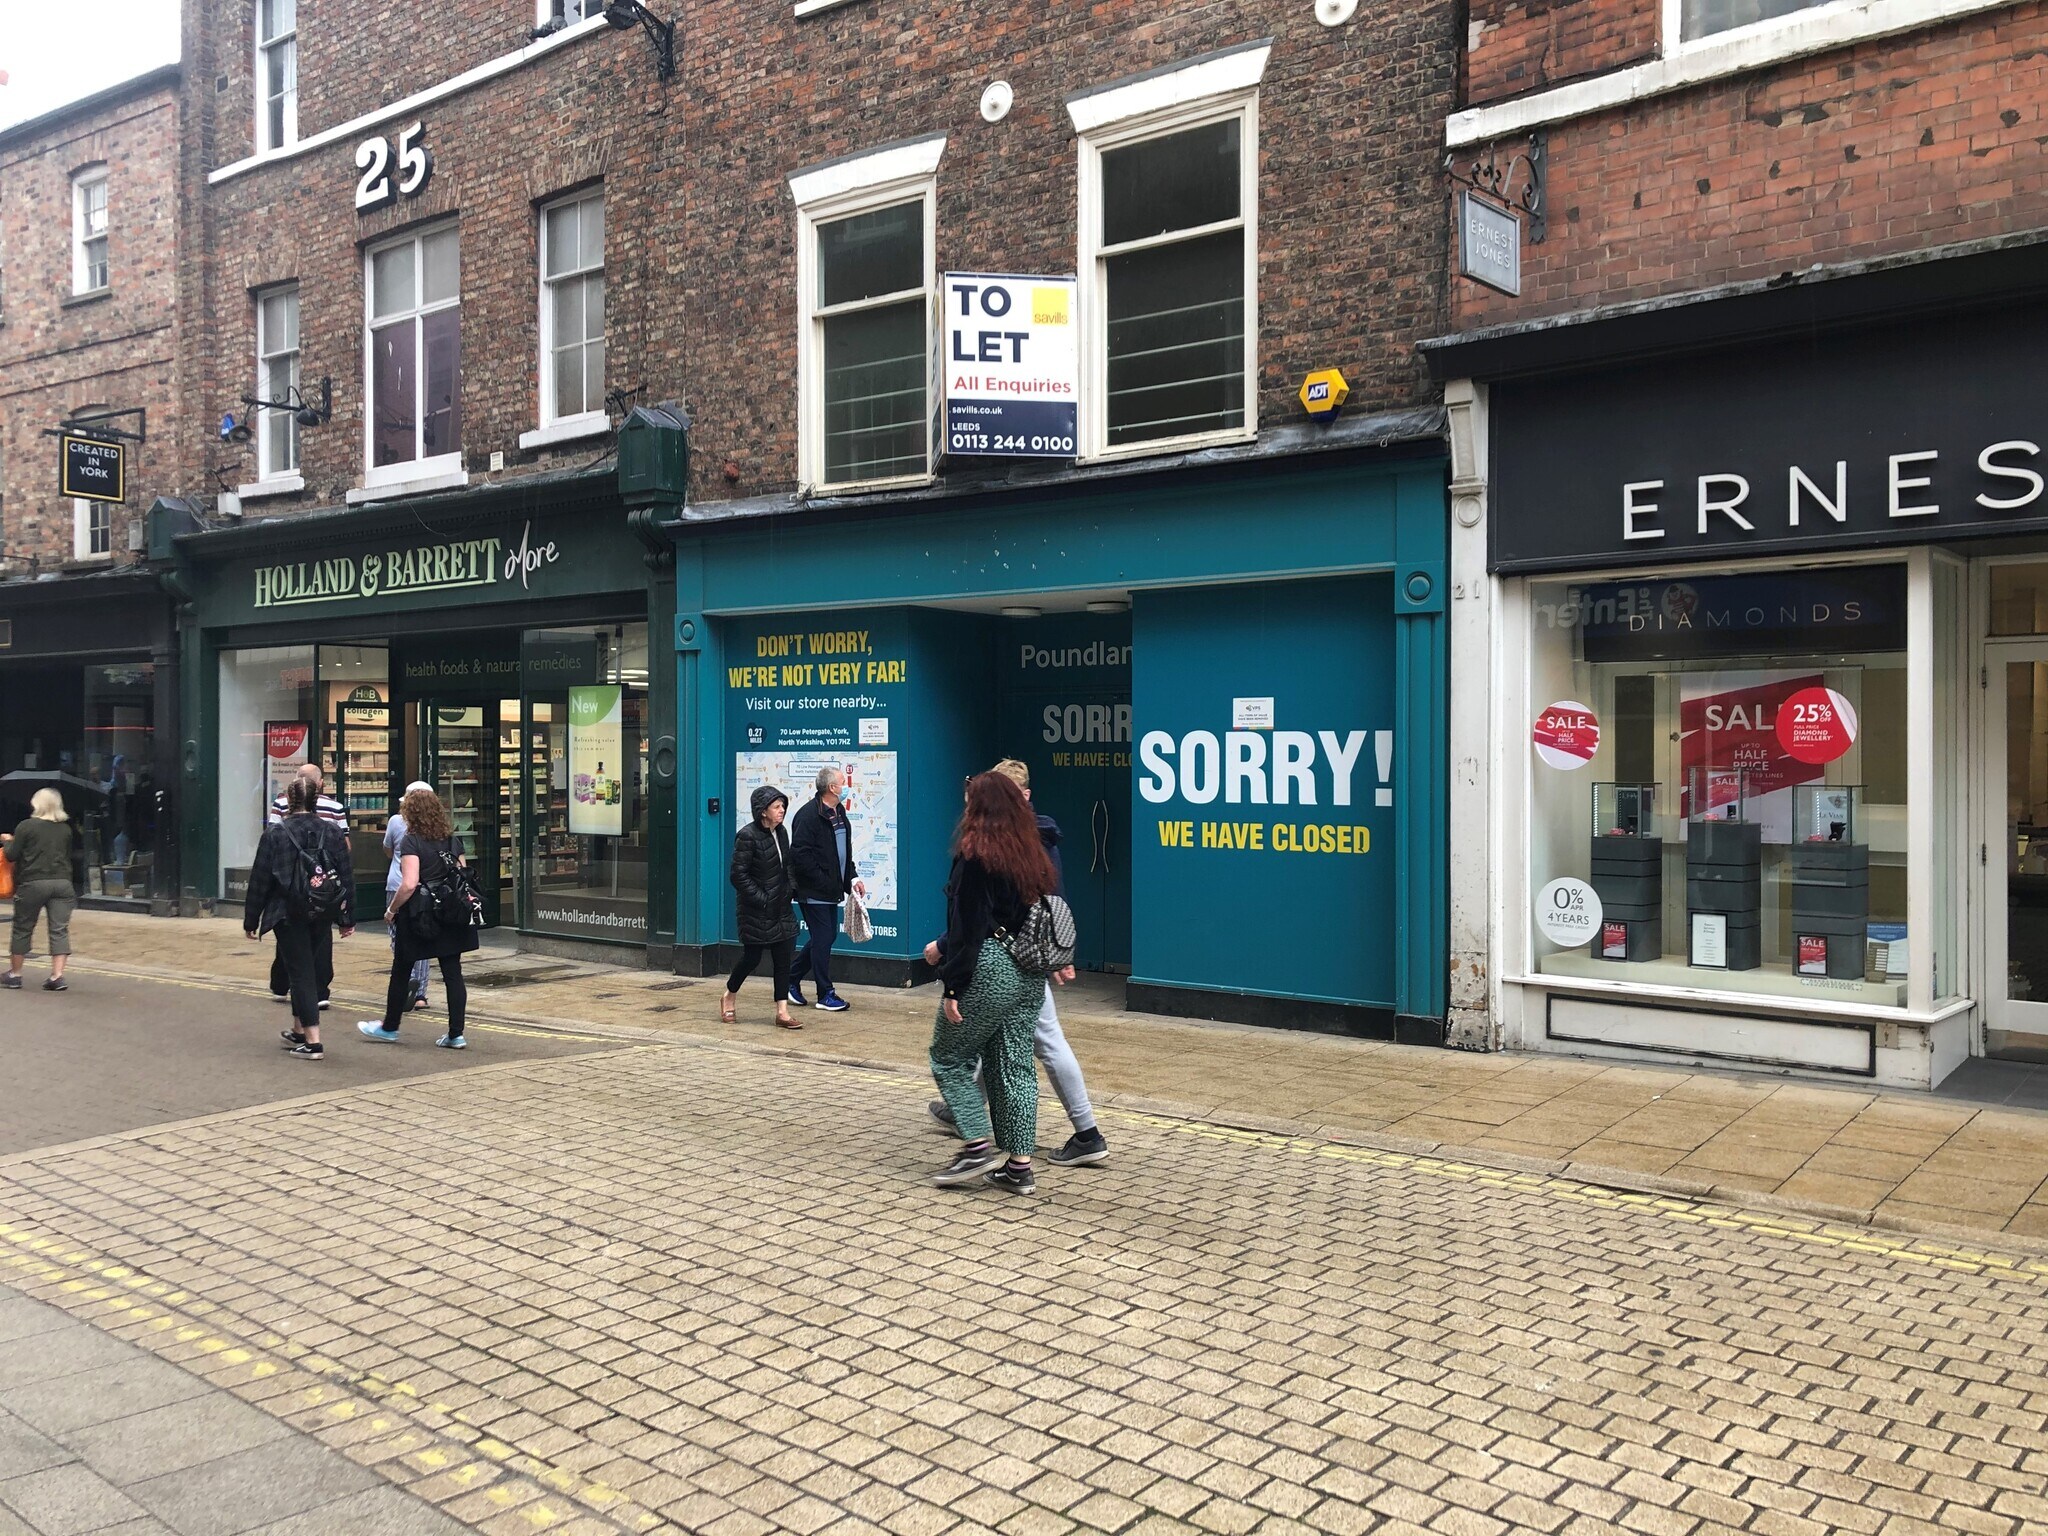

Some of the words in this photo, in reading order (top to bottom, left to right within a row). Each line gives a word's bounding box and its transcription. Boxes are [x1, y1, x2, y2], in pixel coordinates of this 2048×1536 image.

[355, 121, 429, 209] 25
[1471, 219, 1513, 250] ERNEST
[1475, 241, 1511, 269] JONES
[952, 285, 1012, 318] TO
[1034, 312, 1068, 325] savills
[953, 330, 1029, 363] LET
[954, 376, 979, 391] All
[986, 377, 1072, 394] Enquiries
[1307, 384, 1329, 400] ADT
[952, 405, 1003, 415] savills.co.uk
[952, 422, 981, 431] LEEDS
[69, 443, 118, 459] CREATED
[952, 433, 989, 449] 0113
[993, 435, 1026, 450] 244
[1031, 436, 1074, 451] 0100
[88, 456, 100, 466] IN
[79, 466, 109, 479] YORK
[1623, 440, 2045, 540] ERNES
[254, 557, 356, 607] HOLLAND
[360, 553, 382, 597] &
[386, 538, 501, 588] BARRETT
[504, 519, 560, 590] More
[1629, 602, 1862, 632] DIAMONDS
[757, 634, 804, 657] DON'T
[808, 631, 873, 656] WORRY,
[1021, 641, 1132, 669] Poundlan
[405, 661, 437, 678] health
[440, 659, 469, 676] foods
[473, 658, 482, 674] &
[486, 660, 520, 673] natura
[528, 653, 582, 671] remedies
[728, 666, 778, 688] WE'RE
[782, 664, 813, 687] NOT
[818, 662, 862, 685] VERY
[867, 660, 906, 684] FAR!
[571, 695, 598, 714] New
[746, 697, 772, 711] Visit
[774, 699, 795, 710] our
[798, 697, 829, 710] store
[833, 694, 887, 711] nearby...
[1705, 704, 1781, 732] SAL
[1793, 703, 1832, 723] 25%
[1043, 704, 1132, 743] SORR
[1546, 716, 1586, 729] SALE
[748, 728, 763, 738] 0.27
[780, 728, 788, 736] 70
[788, 728, 801, 736] Low
[802, 728, 832, 737] Petergate,
[833, 727, 850, 736] York,
[271, 736, 284, 747] Half
[285, 736, 299, 747] Price
[796, 738, 825, 747] Yorkshire,
[1053, 752, 1071, 767] WE
[1074, 752, 1110, 767] HAVE
[1734, 750, 1768, 760] HALF
[1139, 730, 1393, 807] SORRY!
[1715, 778, 1740, 786] SALE
[1158, 821, 1194, 847] WE
[1202, 822, 1264, 849] HAVE
[1272, 824, 1370, 854] CLOSED
[1554, 887, 1584, 909] 0%
[870, 926, 898, 937] STORES
[1800, 938, 1825, 948] SALE
